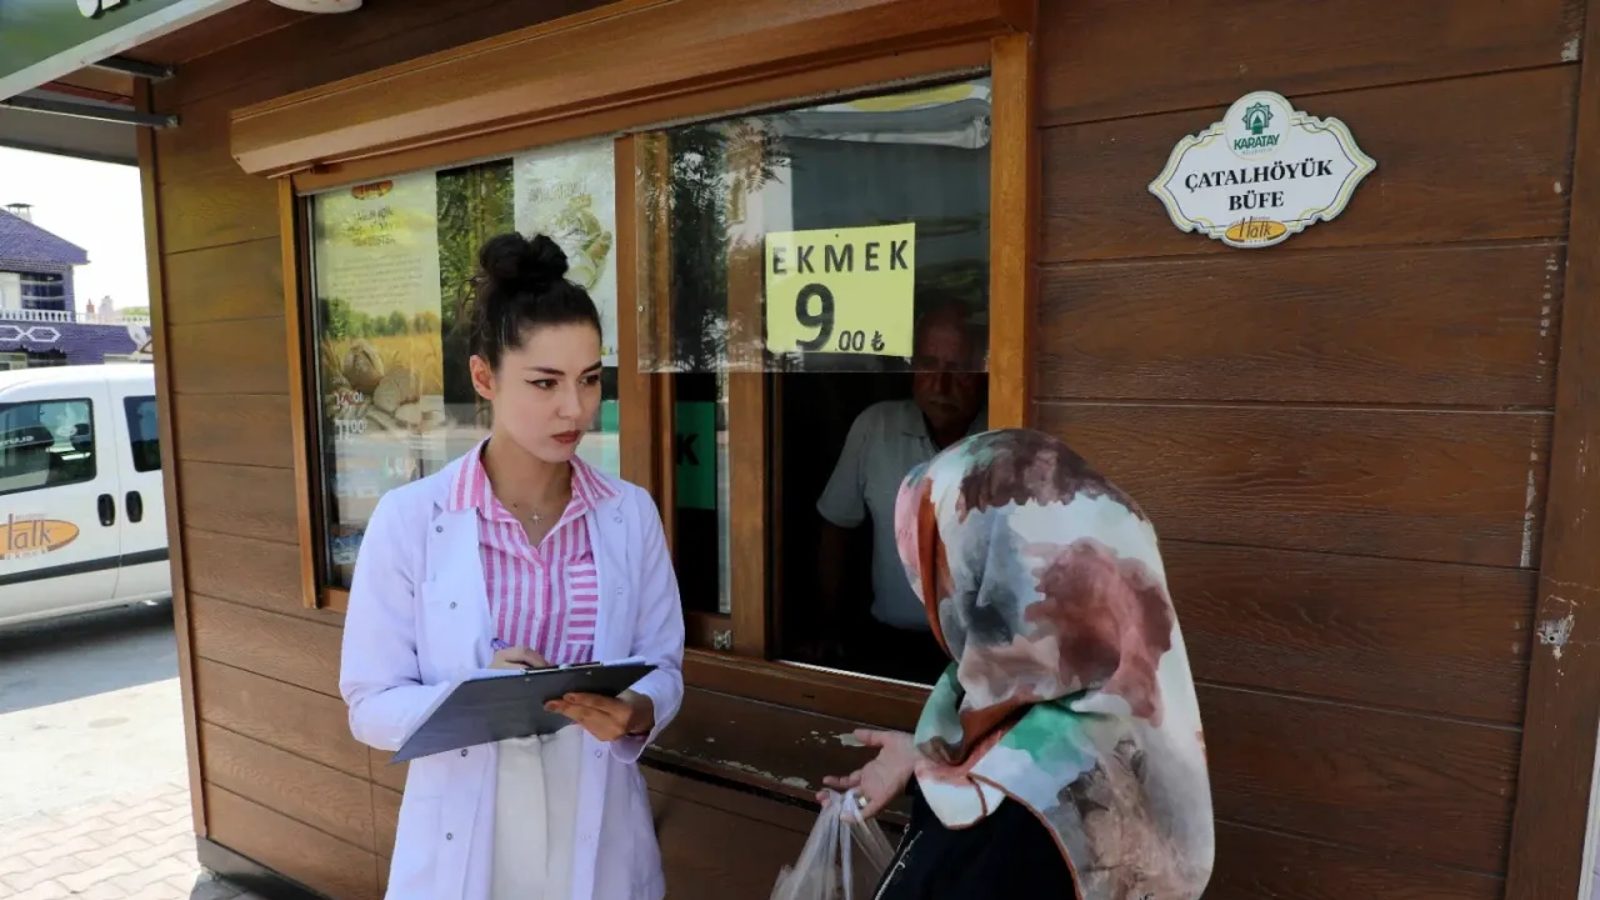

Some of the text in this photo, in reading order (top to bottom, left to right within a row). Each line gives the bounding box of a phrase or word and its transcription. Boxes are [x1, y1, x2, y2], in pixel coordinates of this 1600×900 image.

[1234, 134, 1281, 150] KARATAY
[1185, 158, 1334, 193] ÇATALHÖYÜK
[1228, 190, 1285, 211] BÜFE
[773, 240, 908, 274] EKMEK
